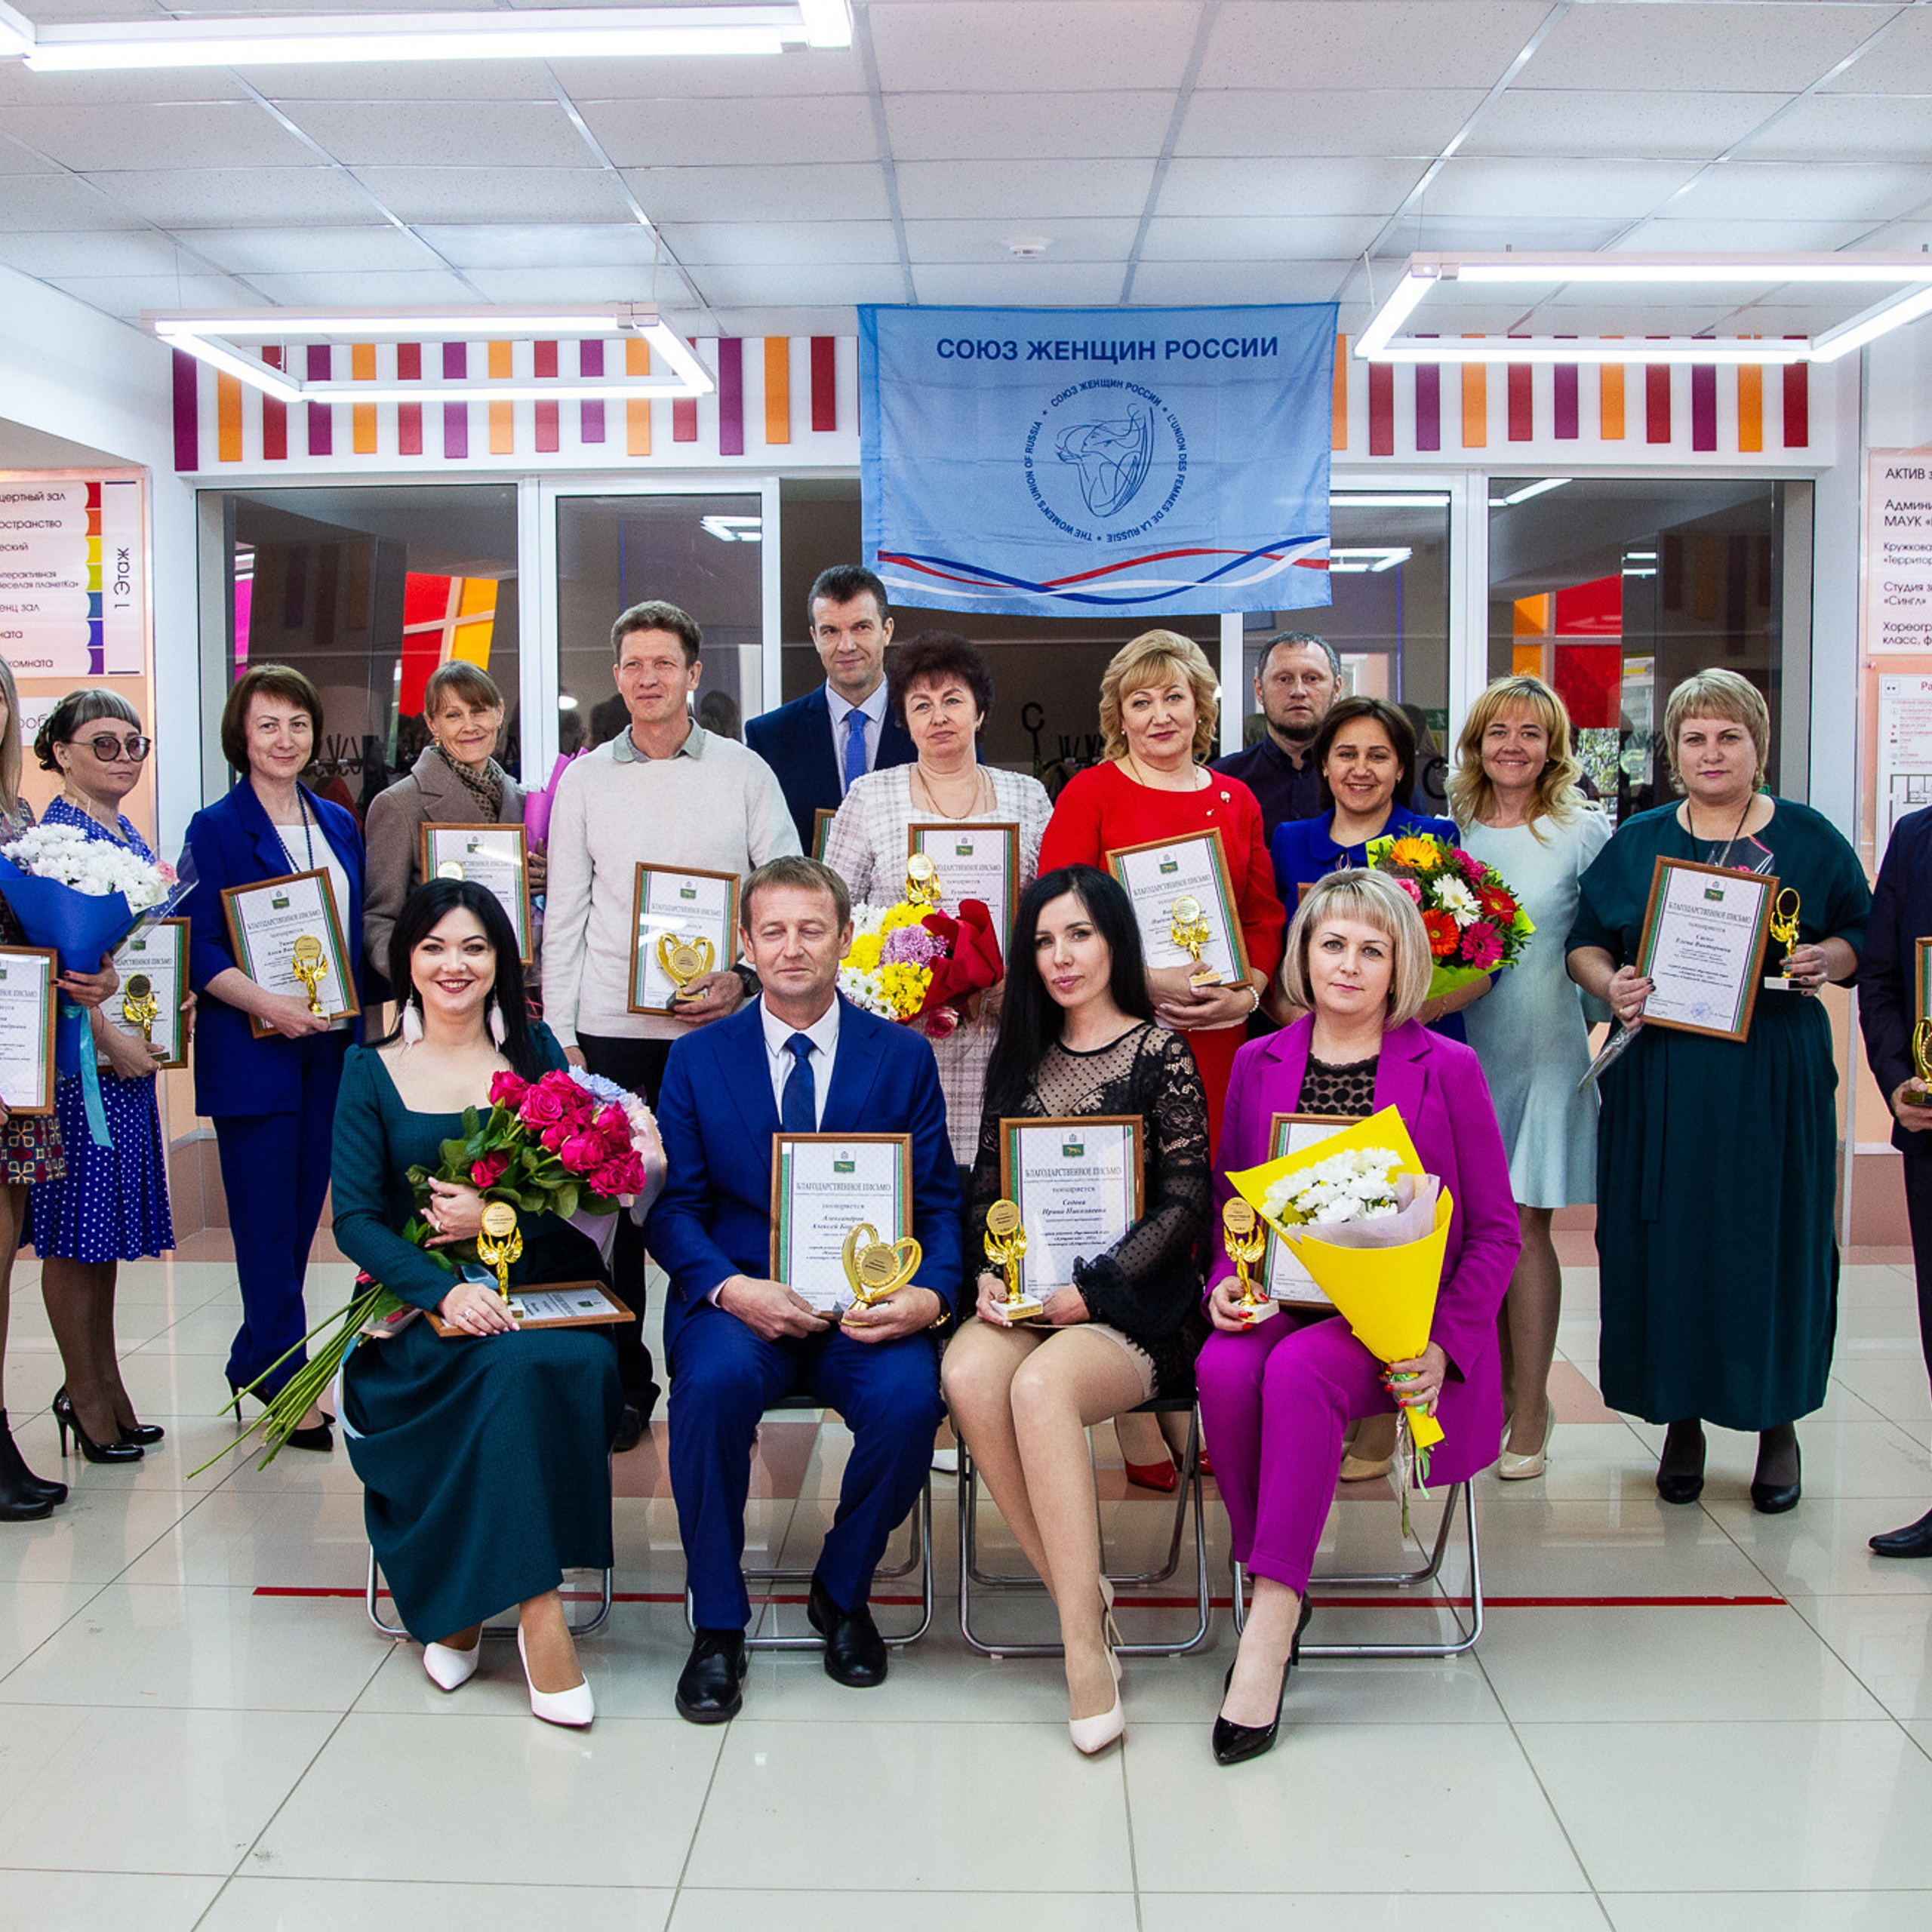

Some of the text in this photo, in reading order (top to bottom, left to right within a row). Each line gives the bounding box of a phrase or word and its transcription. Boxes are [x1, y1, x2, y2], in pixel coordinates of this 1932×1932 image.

[937, 336, 1278, 365] СОЮЗ ЖЕНЩИН РОССИИ
[1051, 378, 1163, 408] СОЮЗ ЖЕНЩИН РОССИИ
[1106, 414, 1187, 543] L'UNION DES FEMMES DE LA RUSSIE
[1884, 468, 1926, 479] АКТИВ
[1023, 421, 1093, 542] THE WOMEN'S UNION OF RUSSIA
[47, 492, 66, 501] зал
[1884, 515, 1921, 527] МАУК
[113, 547, 131, 595] Этаж
[1883, 581, 1924, 592] Студия
[1884, 595, 1926, 605] «Сингл»
[1883, 622, 1932, 633] Хореогр
